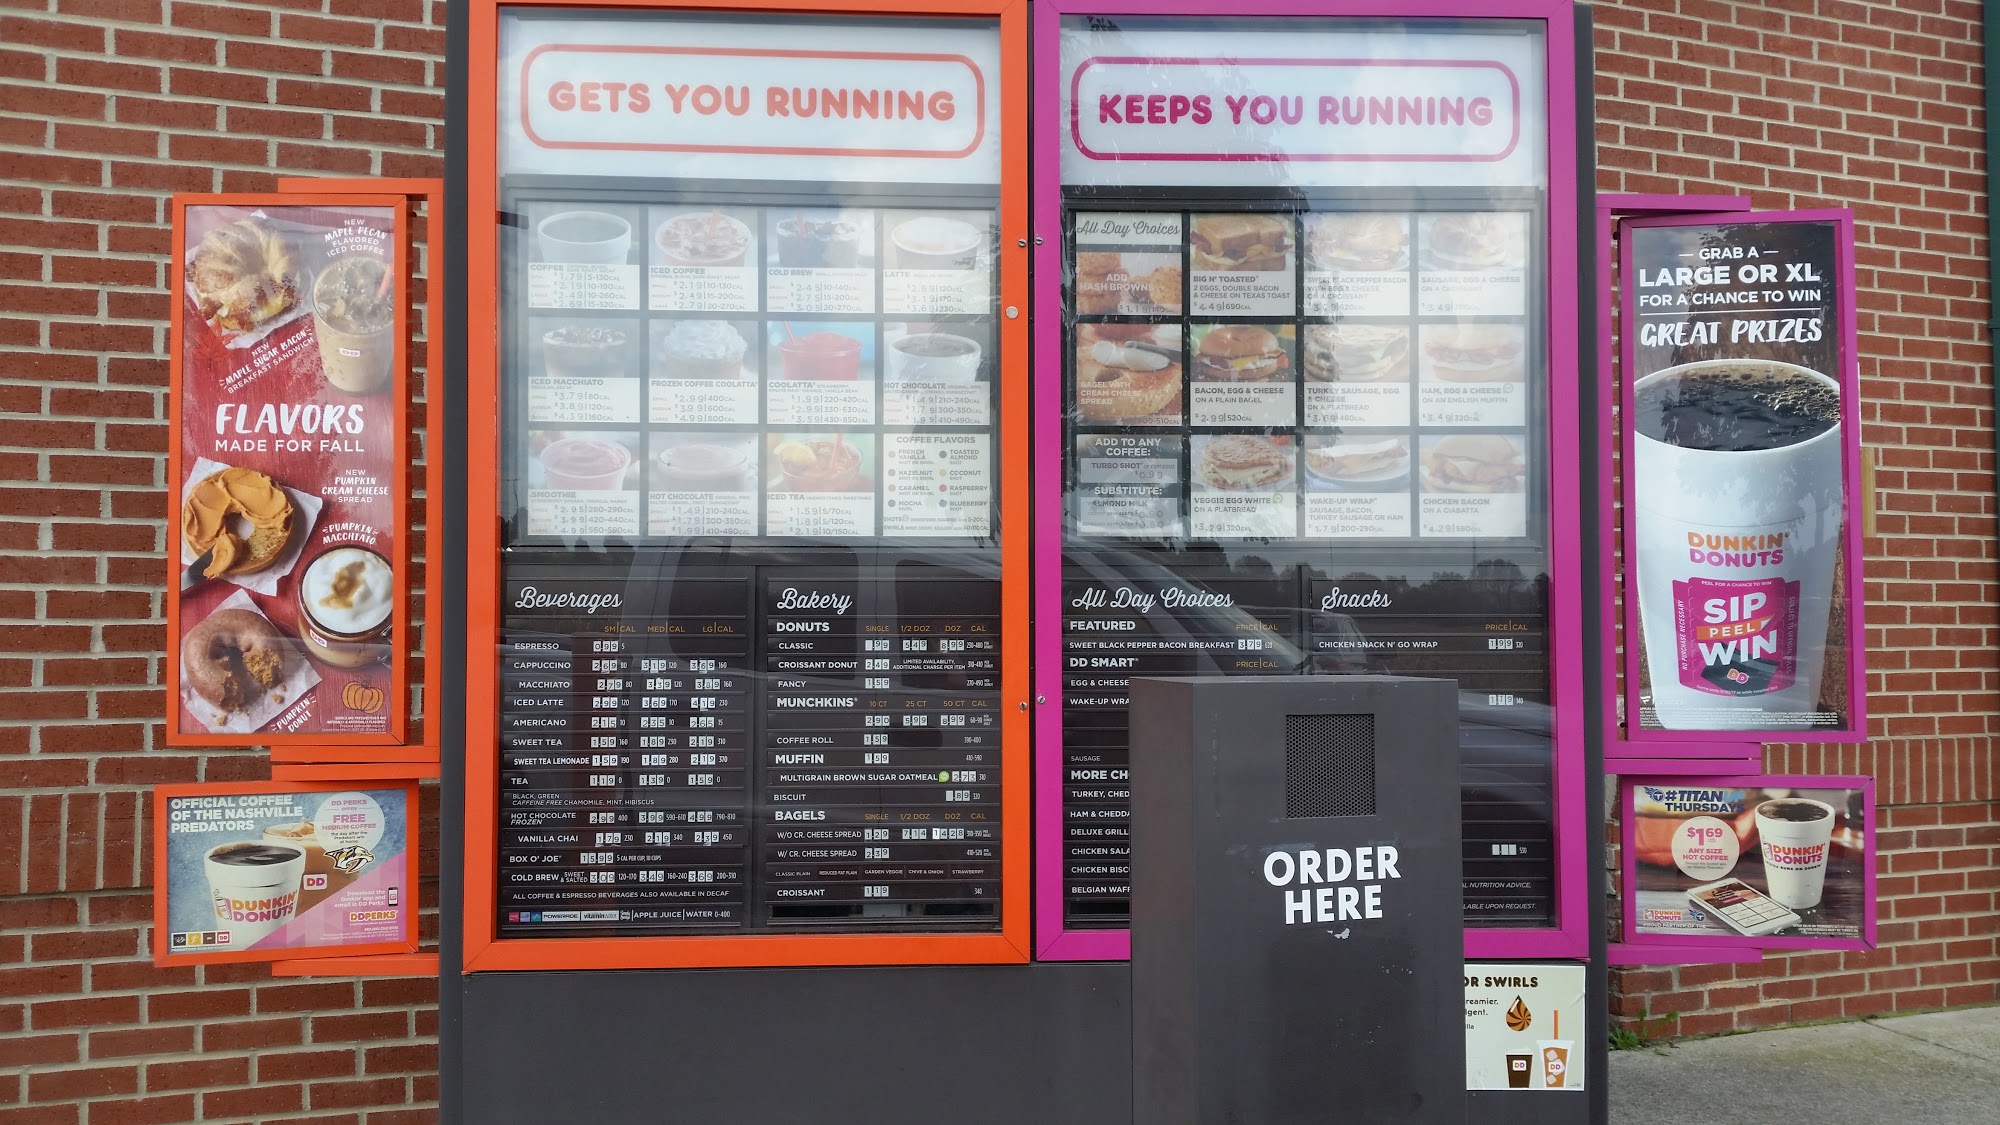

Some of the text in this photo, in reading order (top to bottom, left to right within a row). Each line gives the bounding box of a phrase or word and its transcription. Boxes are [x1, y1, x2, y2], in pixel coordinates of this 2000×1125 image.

[547, 81, 955, 122] GETS YOU RUNNING
[1099, 94, 1493, 126] KEEPS YOU RUNNING
[325, 227, 388, 242] MAPLE PECAN
[1077, 221, 1180, 238] All Day Choices
[332, 237, 379, 247] FLAVORED
[327, 244, 385, 257] ICED COFFEE
[1699, 247, 1759, 260] GRAB A
[1640, 263, 1820, 287] LARGE OR XL
[1640, 290, 1821, 306] FOR A CHANCE TO WIN
[1641, 318, 1822, 347] GREAT PRIZES
[225, 330, 307, 384] MAPLE SUGAR BACON
[251, 342, 270, 357] NEW
[227, 337, 314, 394] BREAKFAST SANDWICH
[216, 403, 364, 434] FLAVORS
[216, 440, 364, 452] MADE FOR FALL
[897, 436, 975, 444] COFFEE FLAVORS
[1106, 448, 1150, 456] COFFEE:
[335, 477, 376, 485] PUMPKIN
[322, 486, 389, 495] CREAM CHEESE
[1094, 487, 1162, 495] SUBSTITUTE:
[329, 522, 372, 533] PUMPKIN
[1689, 549, 1783, 567] DONUTS
[515, 586, 623, 614] Beverages
[777, 587, 853, 615] Bakery
[1072, 586, 1234, 613] All Day Choices
[1321, 586, 1392, 612] Snacks
[1704, 592, 1767, 624] SIP
[777, 622, 830, 632] DONUTS
[1070, 621, 1136, 630] FEATURED
[1709, 623, 1755, 638] PEEL
[1698, 630, 1777, 667] WIN
[1070, 658, 1087, 667] DD
[277, 698, 311, 730] PUMPKIN
[288, 710, 312, 733] DONUT
[776, 754, 824, 764] MUFFIN
[171, 795, 292, 809] OFFICIAL COFFEE
[1665, 803, 1745, 813] THURSDAYS
[171, 806, 303, 821] OF THE NASHVILLE
[333, 814, 365, 823] FREE
[775, 811, 825, 820] BAGELS
[171, 821, 254, 833] PREDATORS
[1774, 853, 1823, 864] DONUTS
[1263, 846, 1401, 887] ORDER
[306, 877, 325, 887] DD
[1284, 885, 1383, 925] HERE
[233, 906, 294, 923] DONUTS
[1485, 977, 1538, 987] SWIRLS
